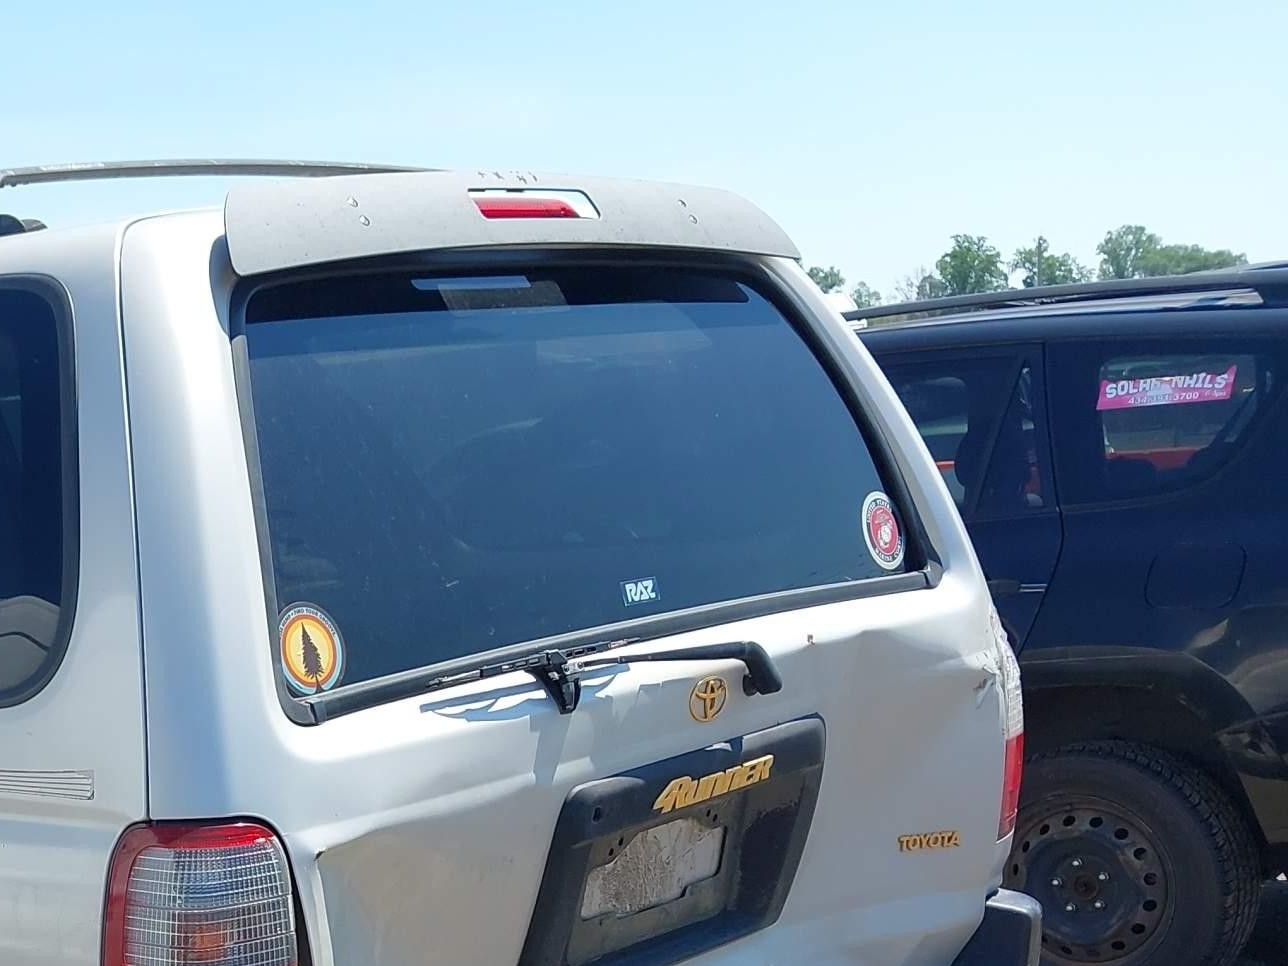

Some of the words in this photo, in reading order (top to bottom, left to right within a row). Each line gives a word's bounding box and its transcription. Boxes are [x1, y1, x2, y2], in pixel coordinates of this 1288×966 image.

[1171, 371, 1229, 389] NAILS
[624, 579, 657, 603] RAZ
[897, 830, 960, 851] TOYOTA
